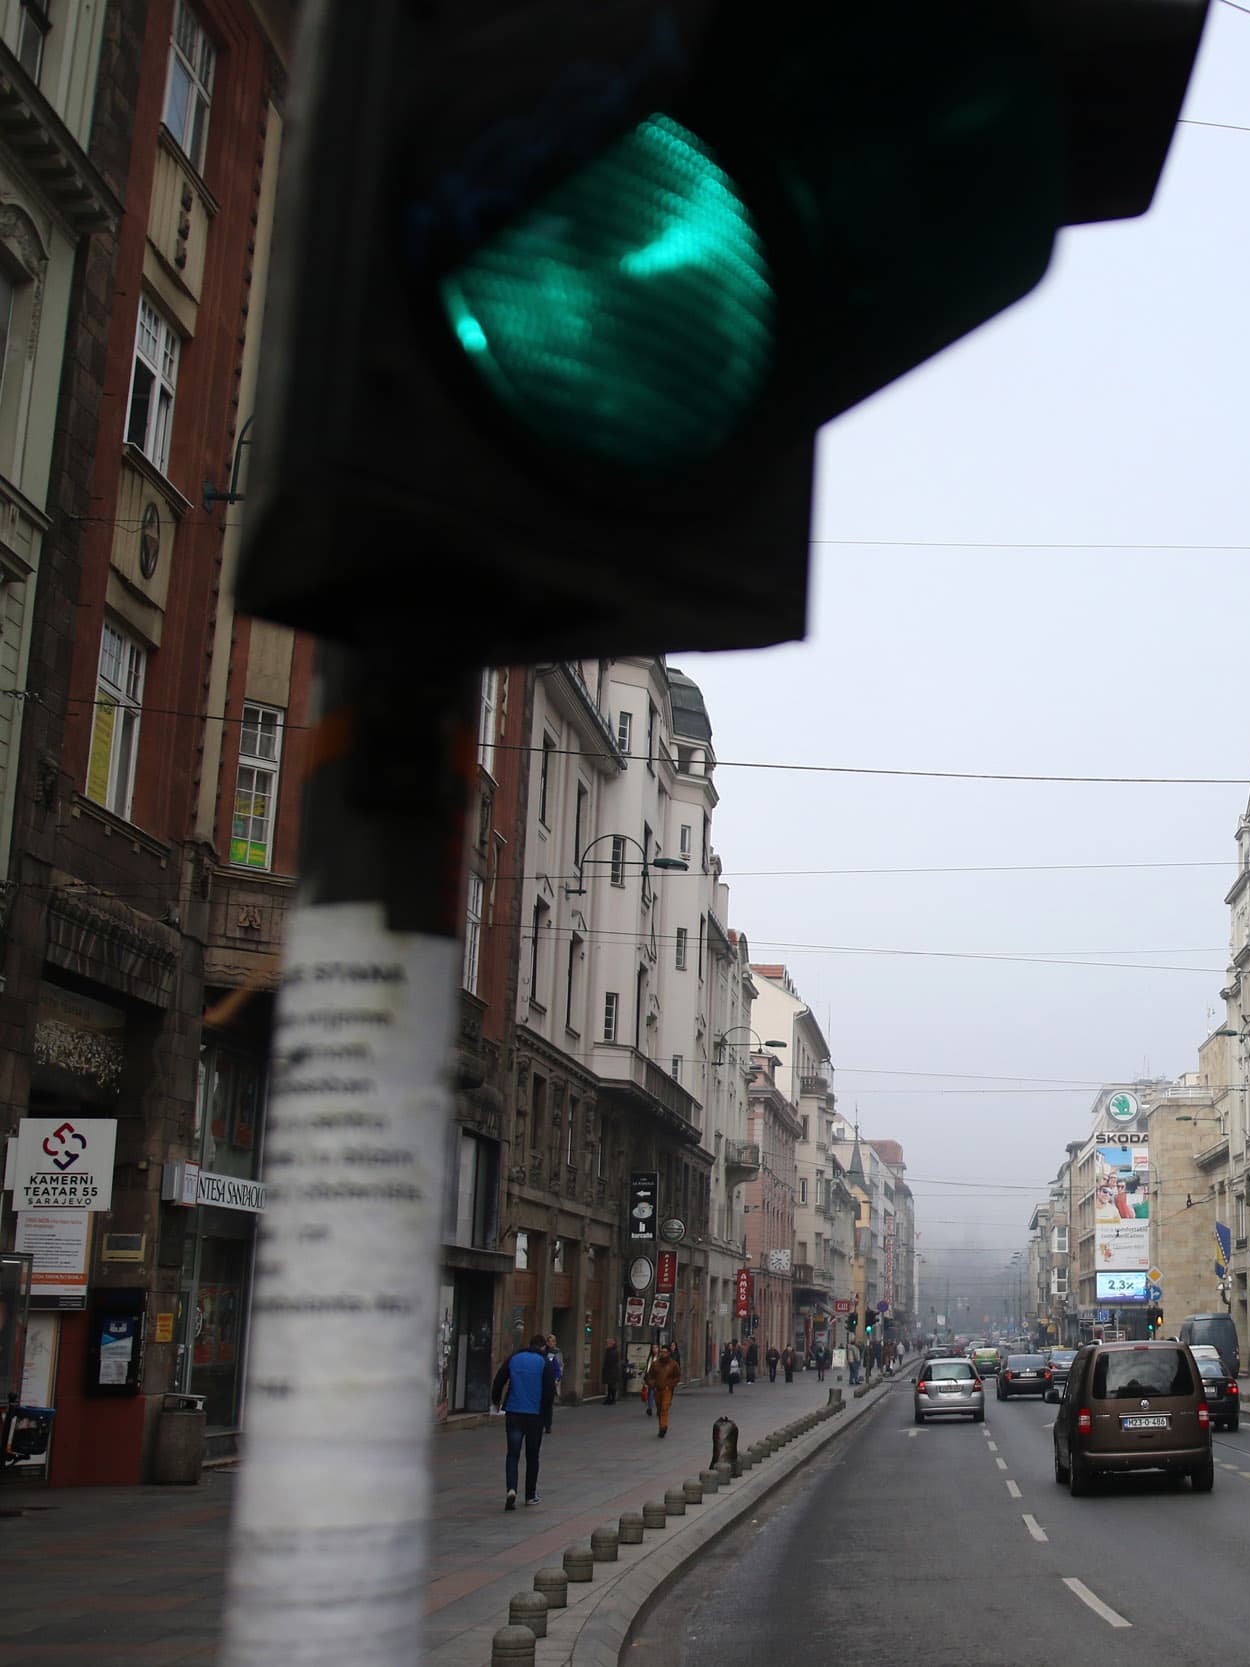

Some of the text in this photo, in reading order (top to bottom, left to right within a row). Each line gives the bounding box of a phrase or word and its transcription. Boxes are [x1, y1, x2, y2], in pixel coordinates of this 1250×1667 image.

[30, 1175, 93, 1185] KAMERNI
[24, 1187, 98, 1196] TEATAR 55
[200, 1177, 225, 1203] NTESA
[740, 1273, 748, 1300] AMKO
[1108, 1280, 1134, 1290] 2.3%
